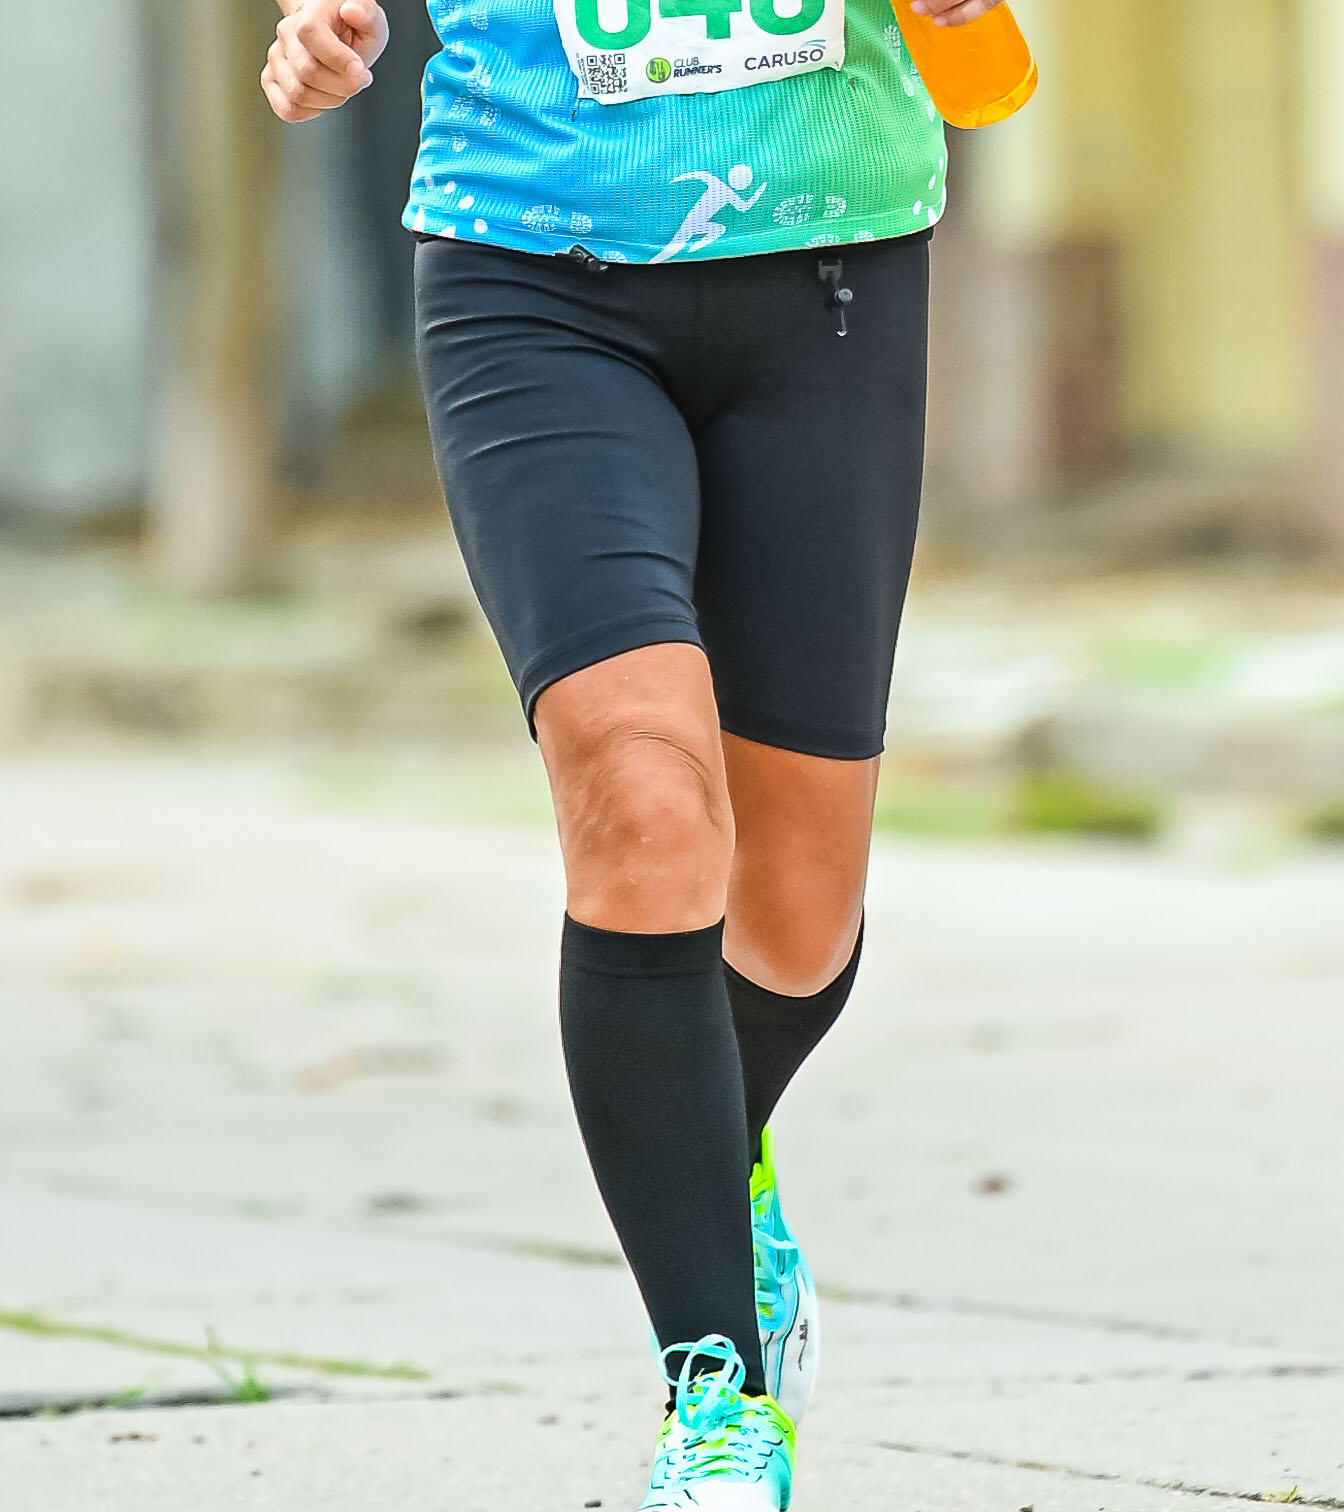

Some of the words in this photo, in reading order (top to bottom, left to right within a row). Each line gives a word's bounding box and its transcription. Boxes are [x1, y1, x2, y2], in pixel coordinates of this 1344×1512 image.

[673, 56, 700, 67] CLUB
[743, 48, 824, 71] CARUSO
[673, 64, 723, 78] RUNNER'S
